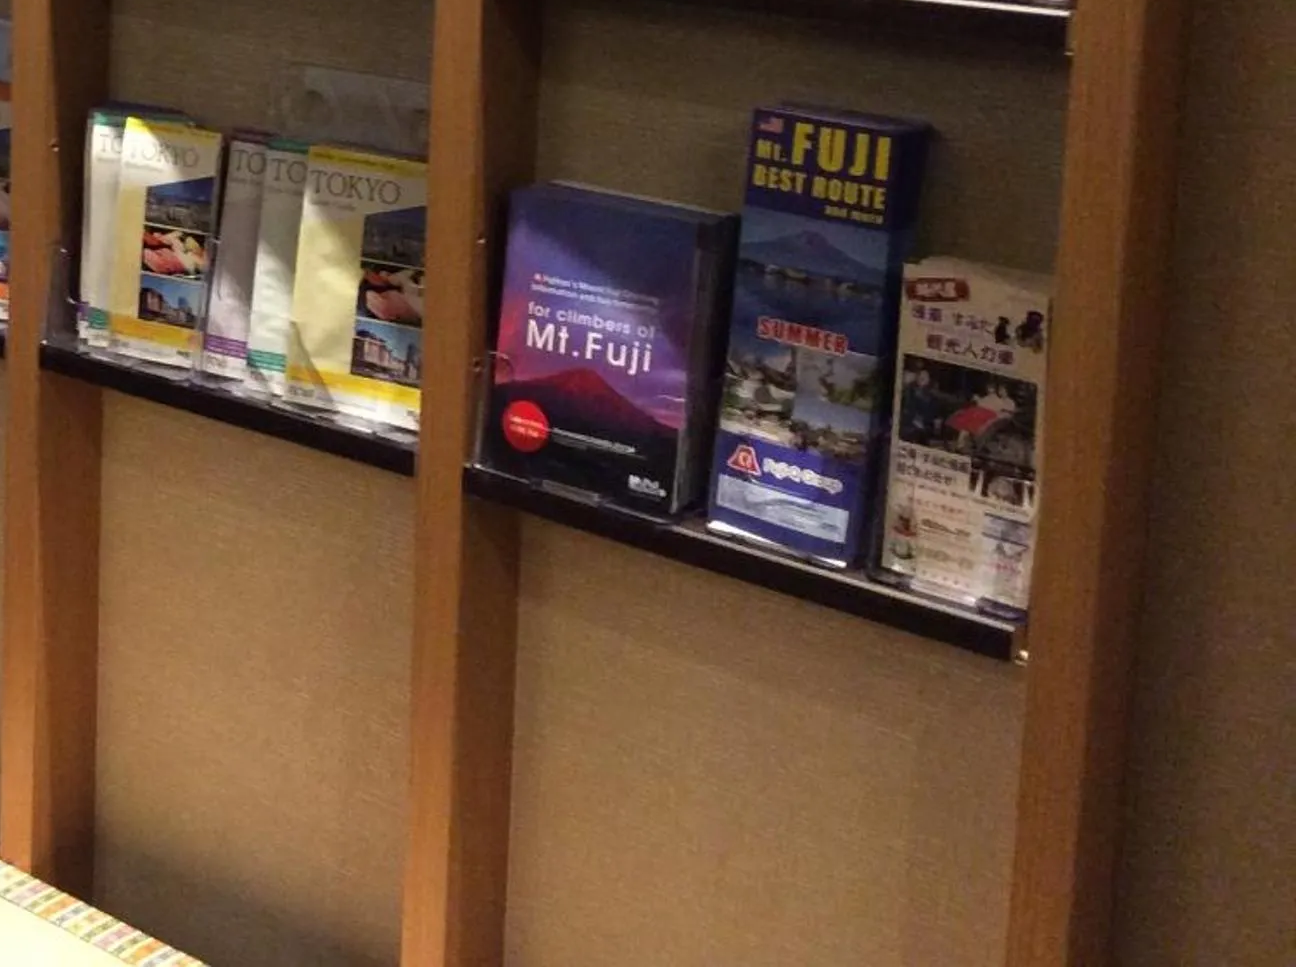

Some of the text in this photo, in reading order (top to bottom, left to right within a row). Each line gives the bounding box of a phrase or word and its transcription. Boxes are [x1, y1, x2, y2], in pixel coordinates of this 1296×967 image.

[792, 122, 892, 181] FUJI
[310, 170, 402, 205] TOKYO
[754, 163, 887, 210] BEST ROUTE
[528, 301, 551, 318] for
[555, 309, 632, 334] climbers
[757, 316, 848, 357] SUMMER
